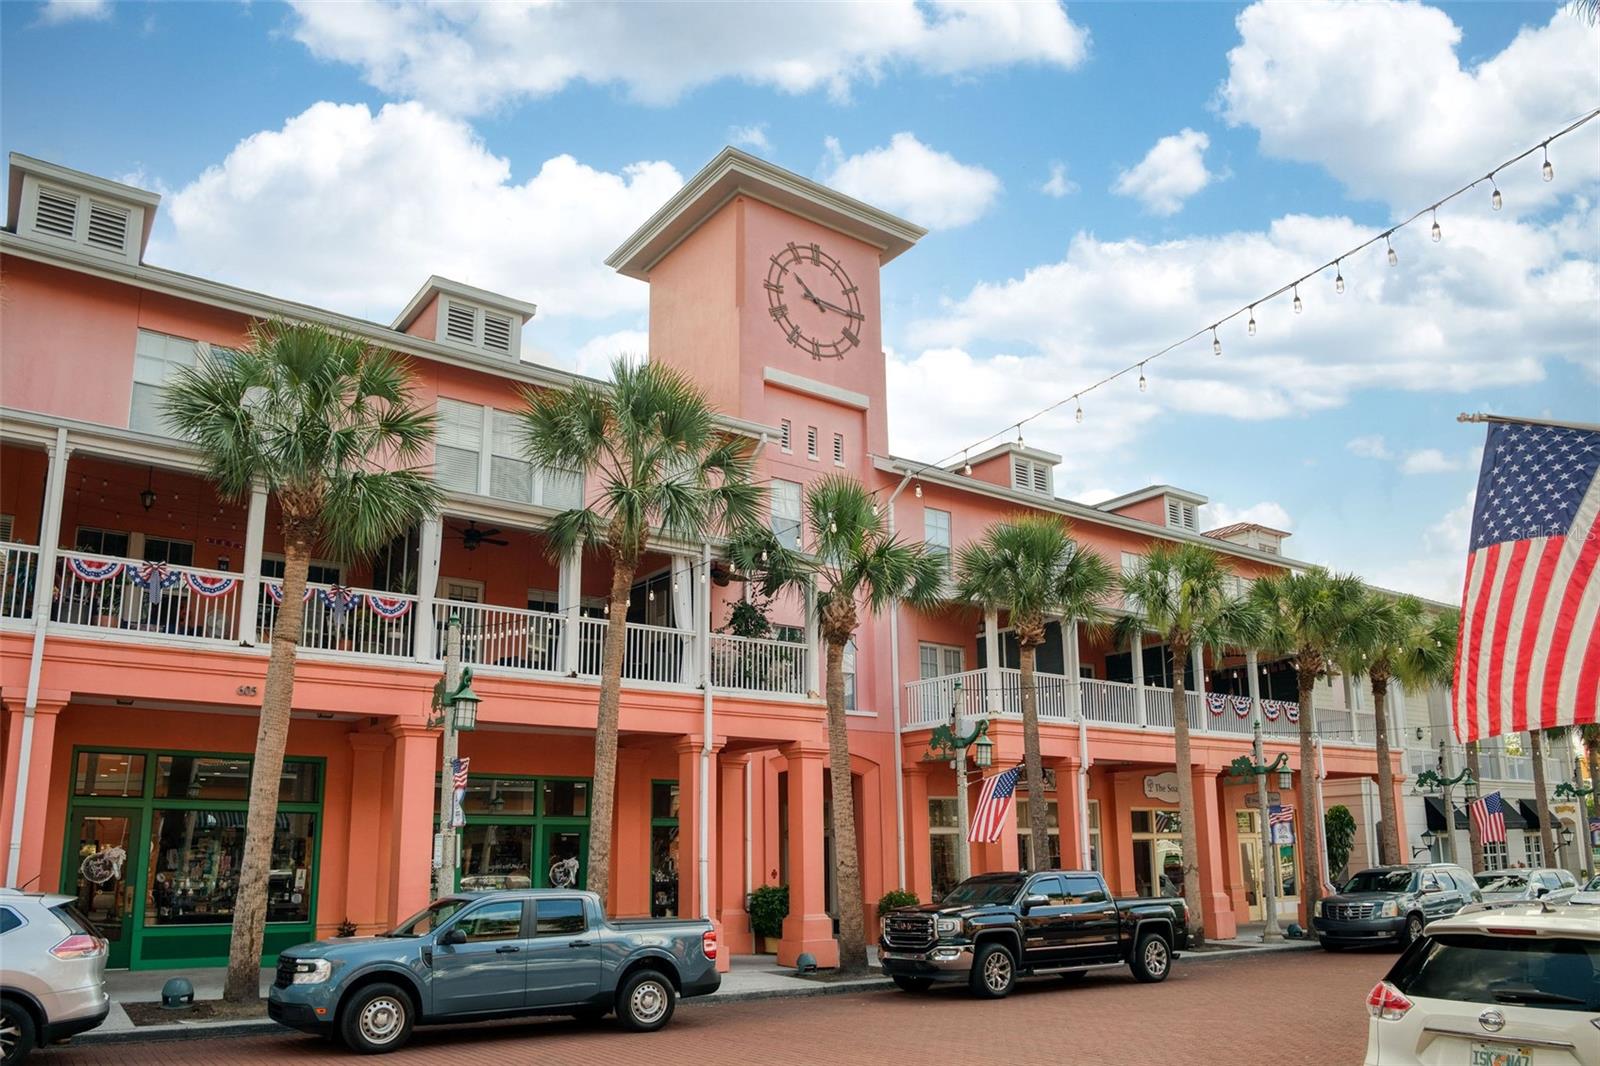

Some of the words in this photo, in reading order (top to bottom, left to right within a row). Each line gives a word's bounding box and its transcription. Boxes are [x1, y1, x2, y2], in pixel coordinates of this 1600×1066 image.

[236, 685, 257, 698] 605
[1155, 783, 1166, 792] The
[1167, 783, 1178, 792] Soa
